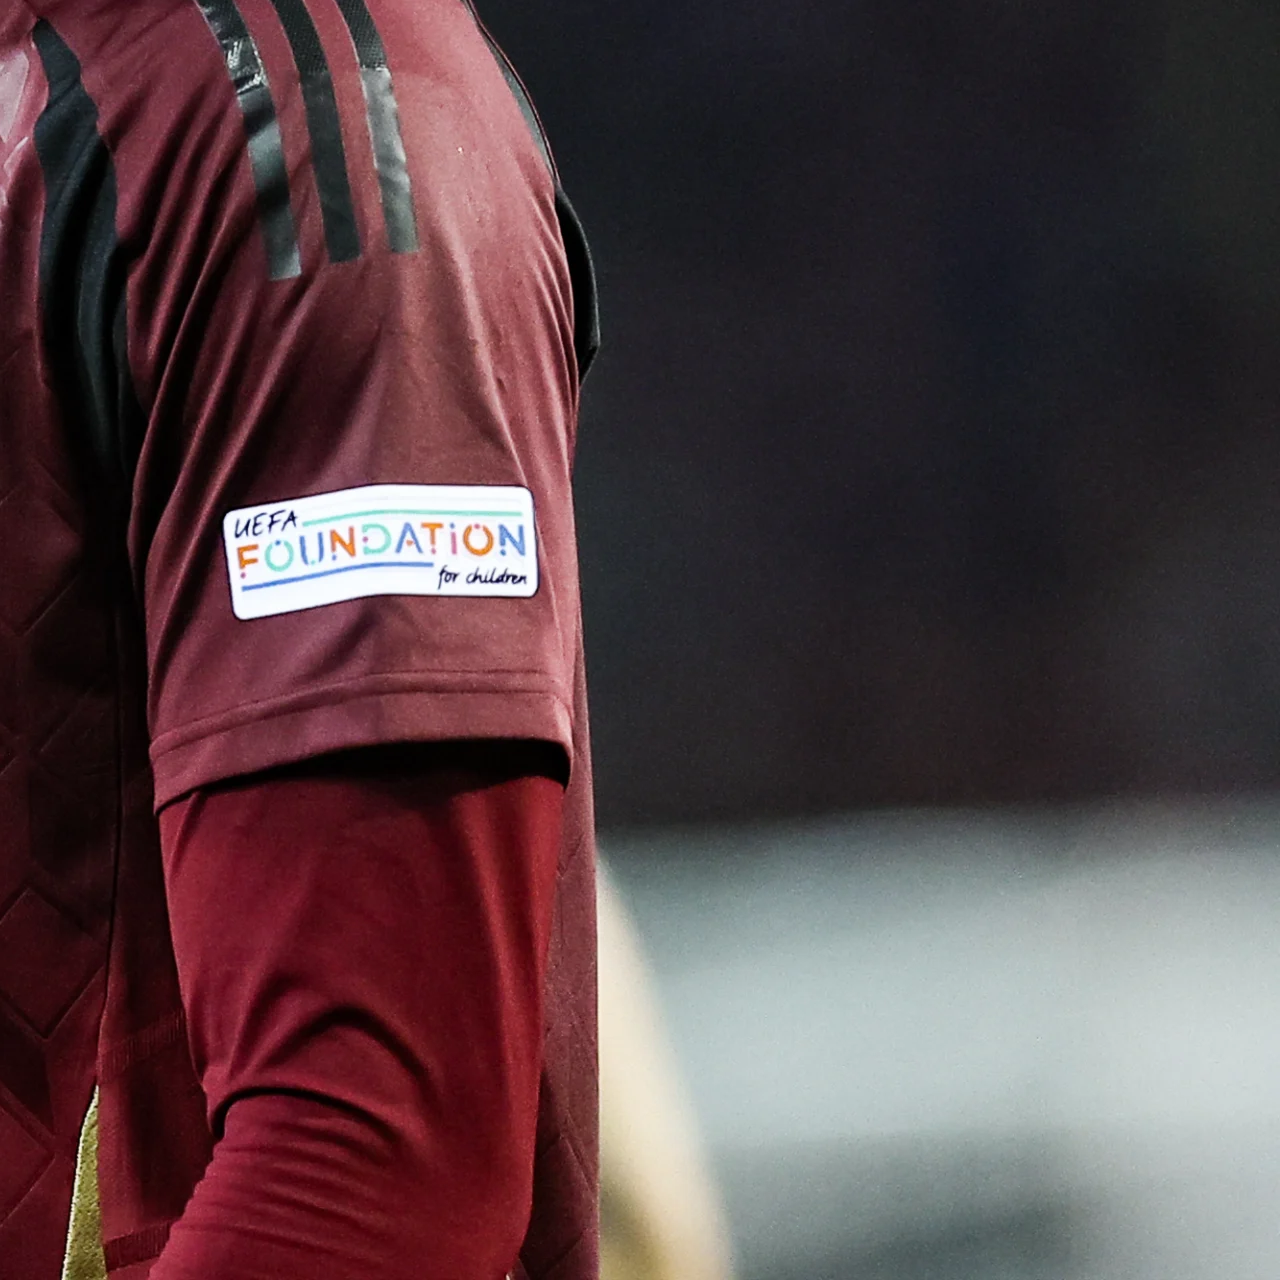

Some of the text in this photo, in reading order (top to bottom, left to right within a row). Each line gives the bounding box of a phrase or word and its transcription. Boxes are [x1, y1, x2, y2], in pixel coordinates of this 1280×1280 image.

[234, 510, 297, 539] UEFA
[237, 522, 526, 579] FOUNDATION
[437, 566, 528, 590] for children
